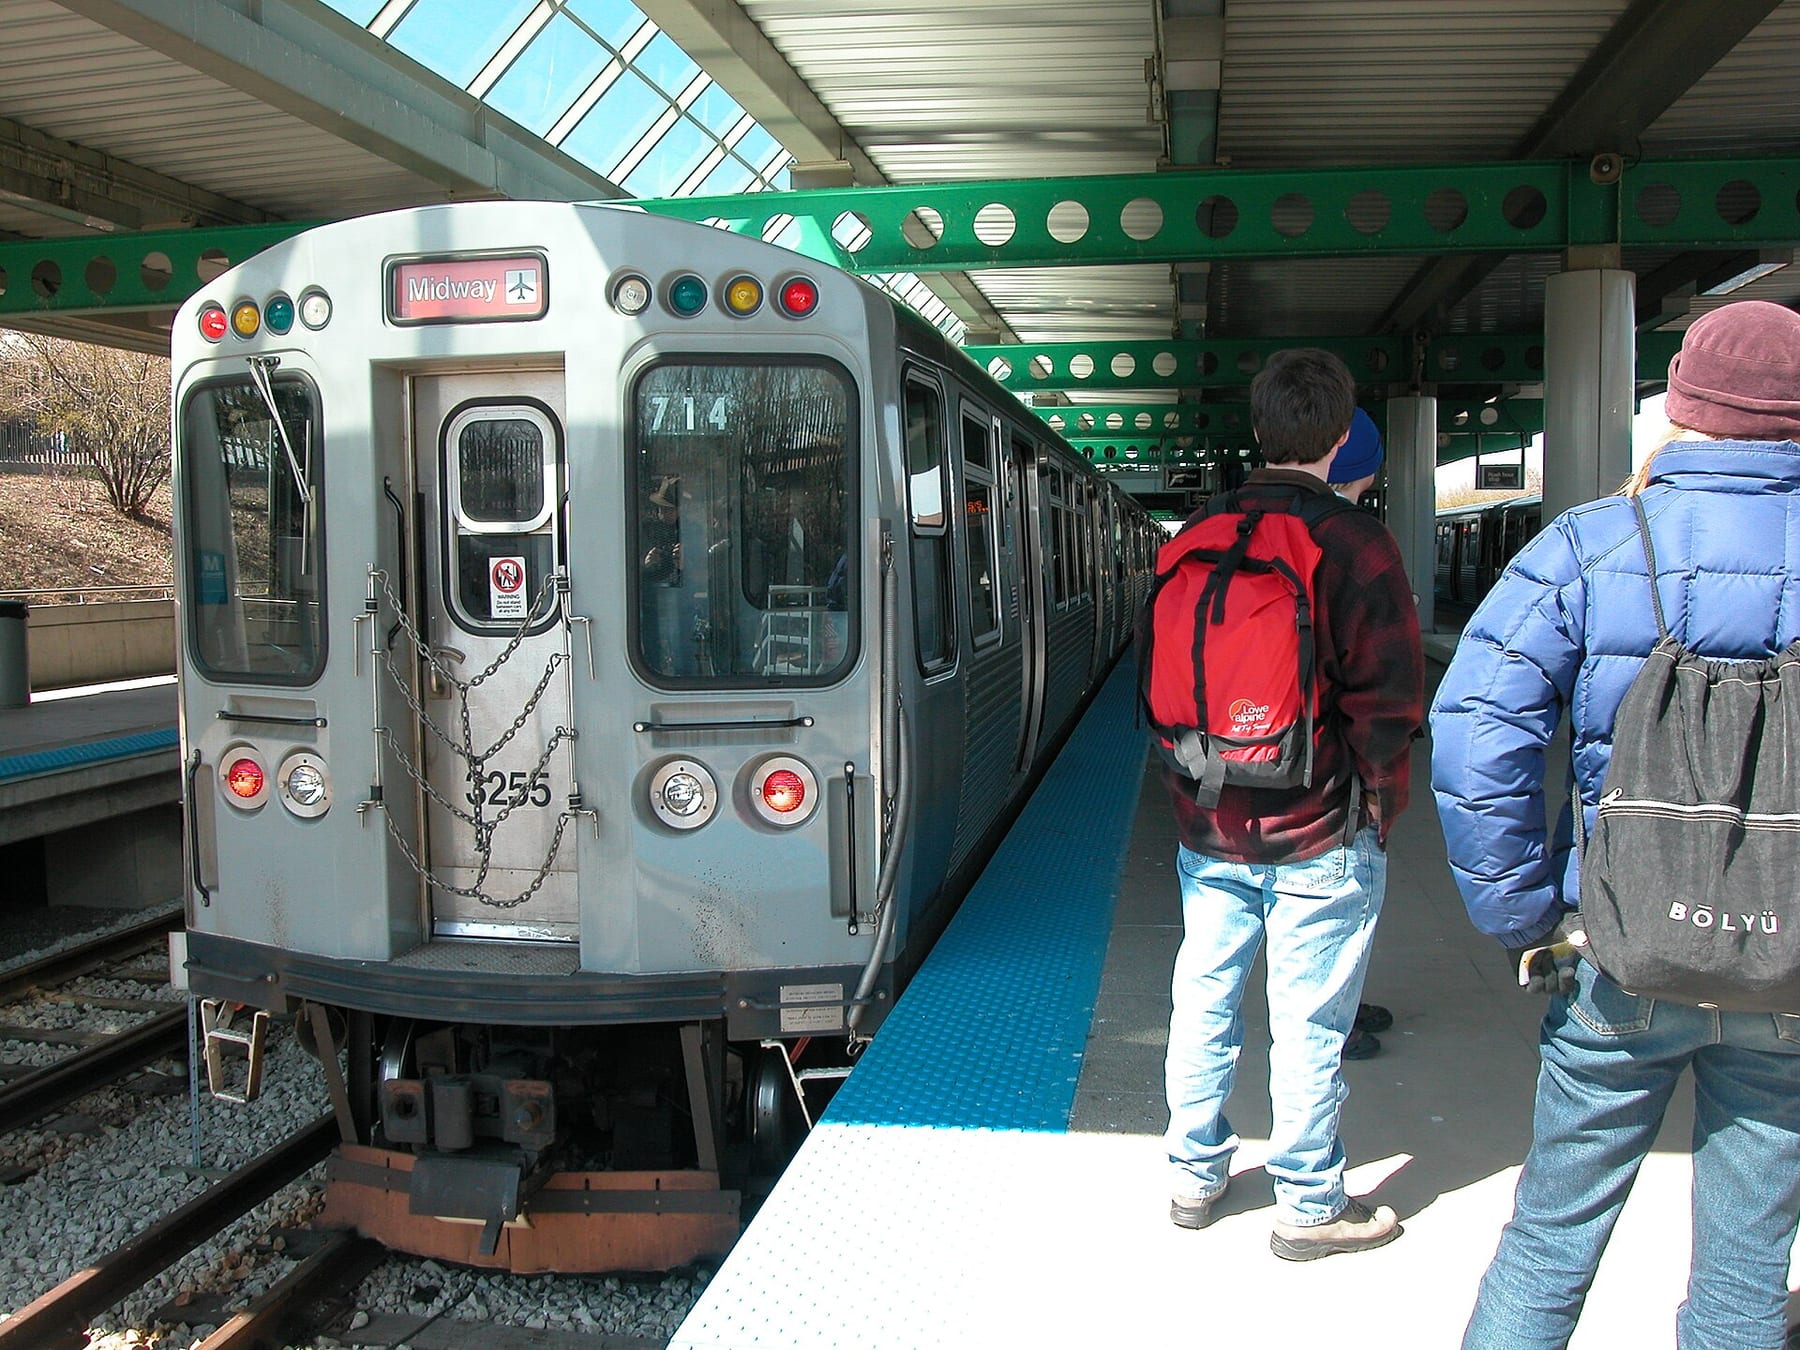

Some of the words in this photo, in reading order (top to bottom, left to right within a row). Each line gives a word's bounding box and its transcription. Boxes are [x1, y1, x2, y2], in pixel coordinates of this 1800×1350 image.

[408, 276, 497, 303] Midway
[652, 396, 728, 431] 714
[1235, 712, 1266, 723] alpine
[1243, 705, 1270, 714] Lowe
